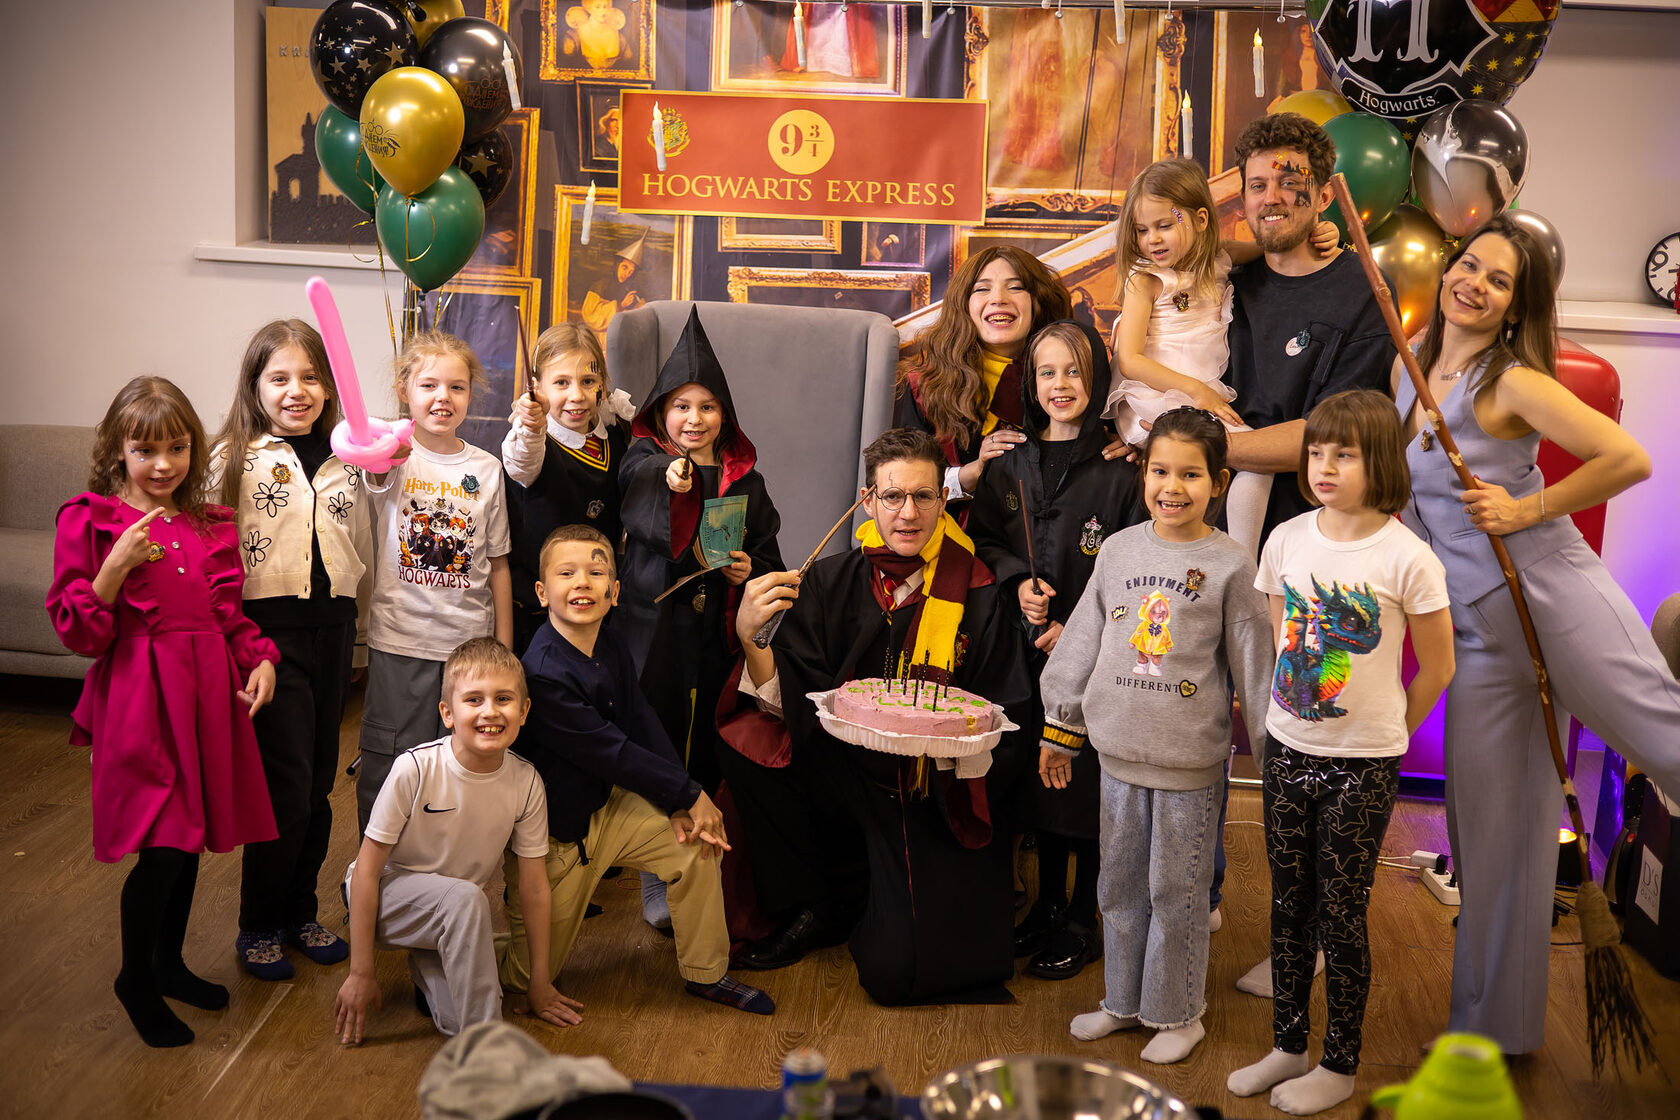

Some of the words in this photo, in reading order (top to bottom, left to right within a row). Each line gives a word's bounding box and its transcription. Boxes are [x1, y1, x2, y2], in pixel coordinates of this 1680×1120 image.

[1359, 89, 1436, 113] Hogwarts
[642, 172, 812, 202] HOGWARTS
[826, 179, 956, 206] EXPRESS
[404, 478, 439, 495] Harry
[398, 565, 471, 589] HOGWARTS
[1125, 575, 1201, 603] ENJOYMENT
[1116, 676, 1181, 694] DIFFERENT
